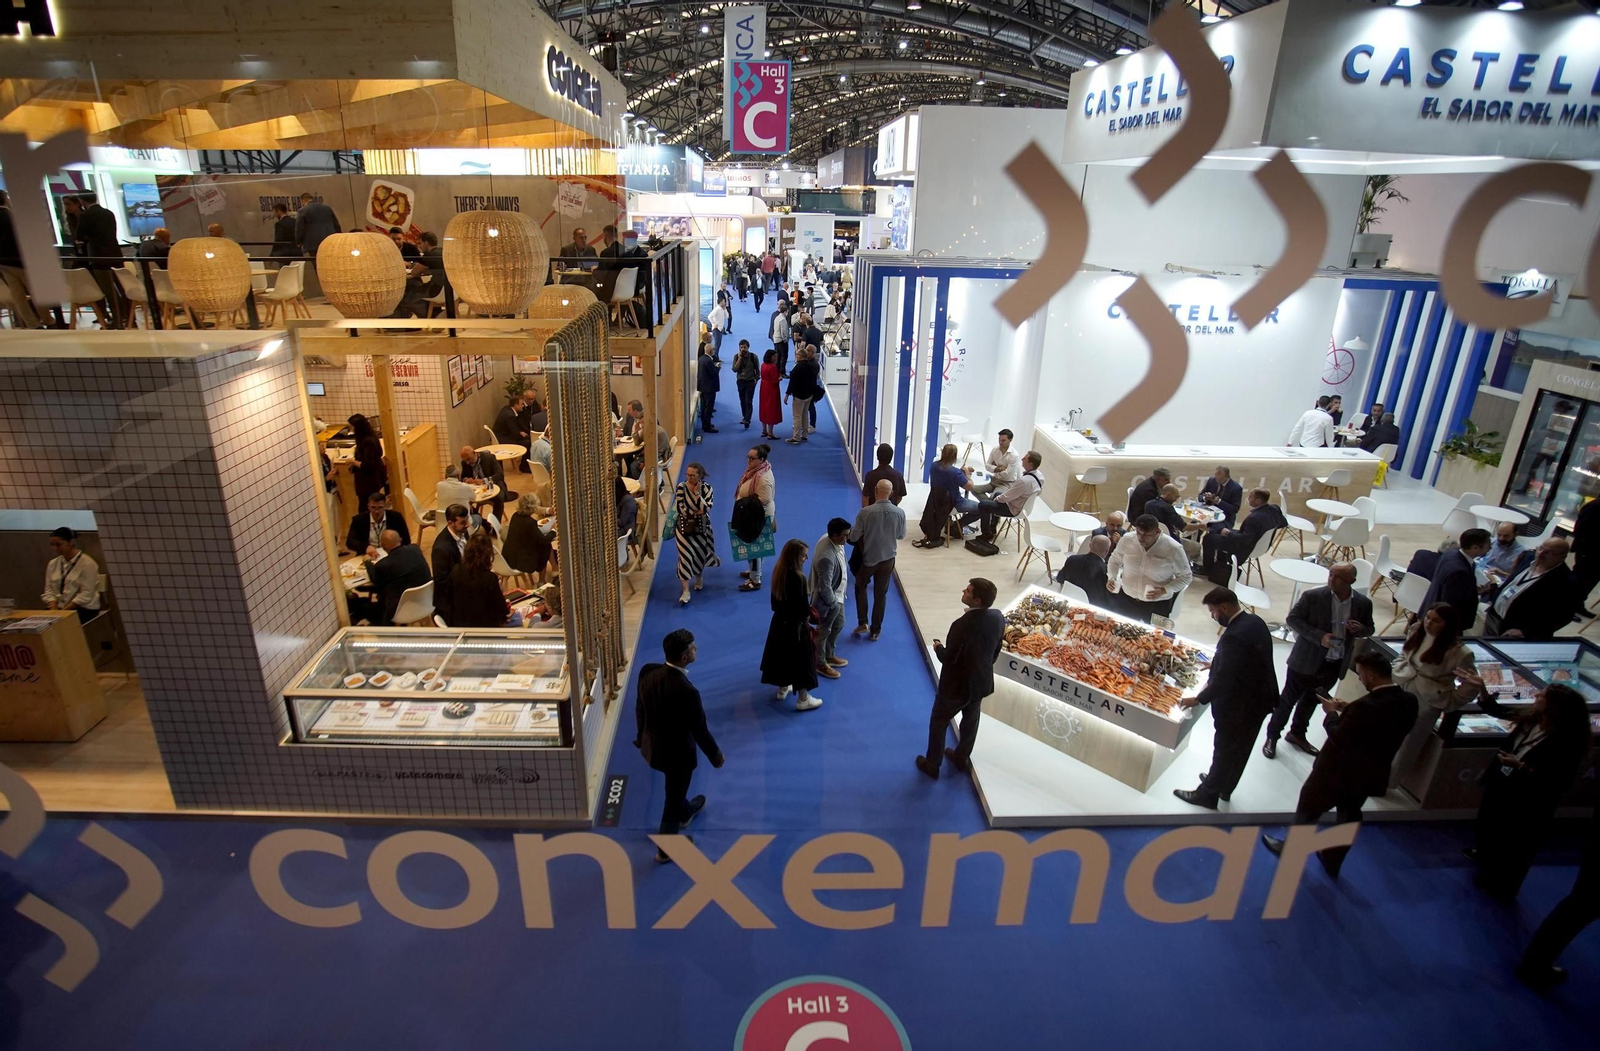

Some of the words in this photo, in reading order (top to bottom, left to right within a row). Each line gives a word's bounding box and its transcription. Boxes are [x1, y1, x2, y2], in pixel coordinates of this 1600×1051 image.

[761, 66, 785, 77] Hall
[1342, 43, 1600, 97] CASTEL
[774, 79, 784, 95] 3
[1109, 119, 1117, 132] EL
[1118, 114, 1143, 131] SABOR
[1145, 110, 1160, 126] DEL
[1162, 107, 1182, 123] MAR
[1420, 96, 1441, 120] EL
[1447, 97, 1513, 122] SABOR
[1517, 101, 1553, 125] DEL
[743, 101, 777, 149] C
[454, 196, 485, 213] THERE'S
[1195, 325, 1212, 334] DEL
[1215, 326, 1235, 335] MAR
[396, 365, 419, 377] SERVIR
[1009, 660, 1125, 716] CASTELLAR
[1033, 681, 1042, 689] EL
[1042, 685, 1063, 699] SABOR
[1065, 695, 1077, 704] DEL
[1079, 701, 1094, 712] MAR
[607, 779, 624, 804] 3C02
[249, 821, 1357, 929] conxemar
[787, 996, 830, 1014] Hall
[836, 996, 849, 1013] 3
